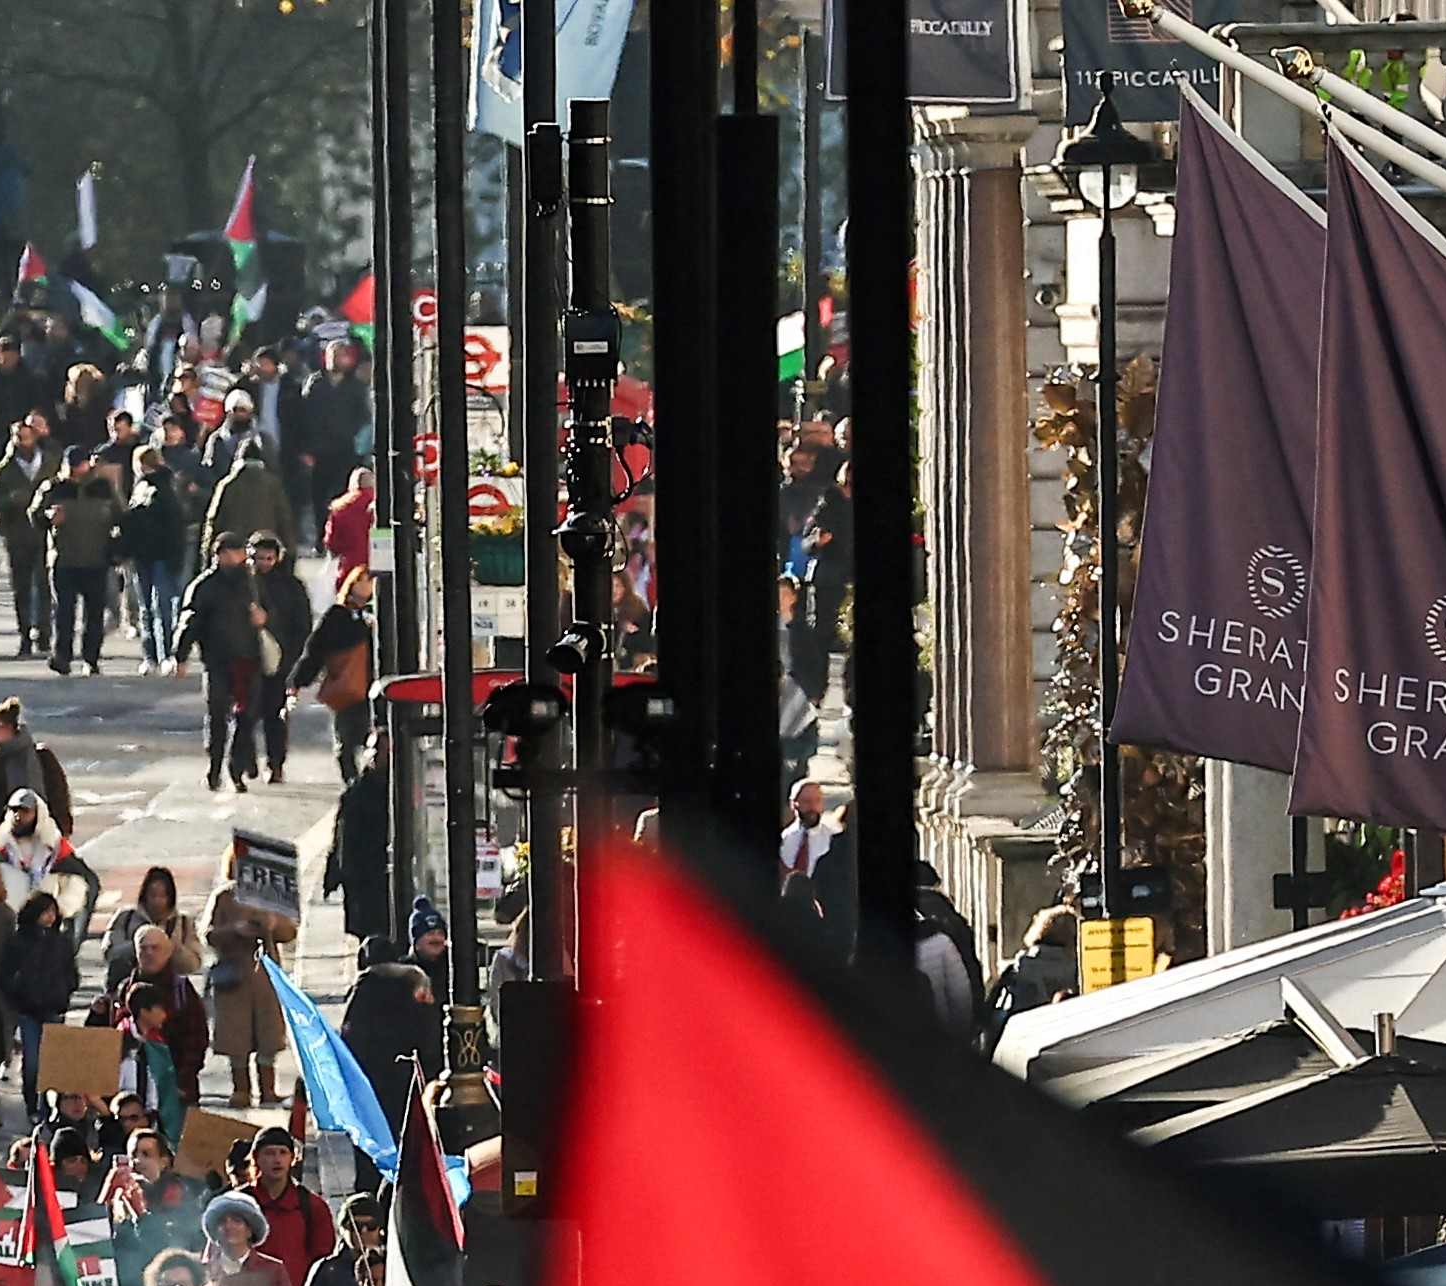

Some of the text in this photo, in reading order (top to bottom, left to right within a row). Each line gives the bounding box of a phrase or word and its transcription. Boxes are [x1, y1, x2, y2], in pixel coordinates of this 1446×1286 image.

[910, 20, 993, 36] PICCADILLY
[1111, 66, 1225, 87] PICCADILL
[1157, 610, 1308, 669] SHERAT
[1194, 664, 1305, 710] GRAN
